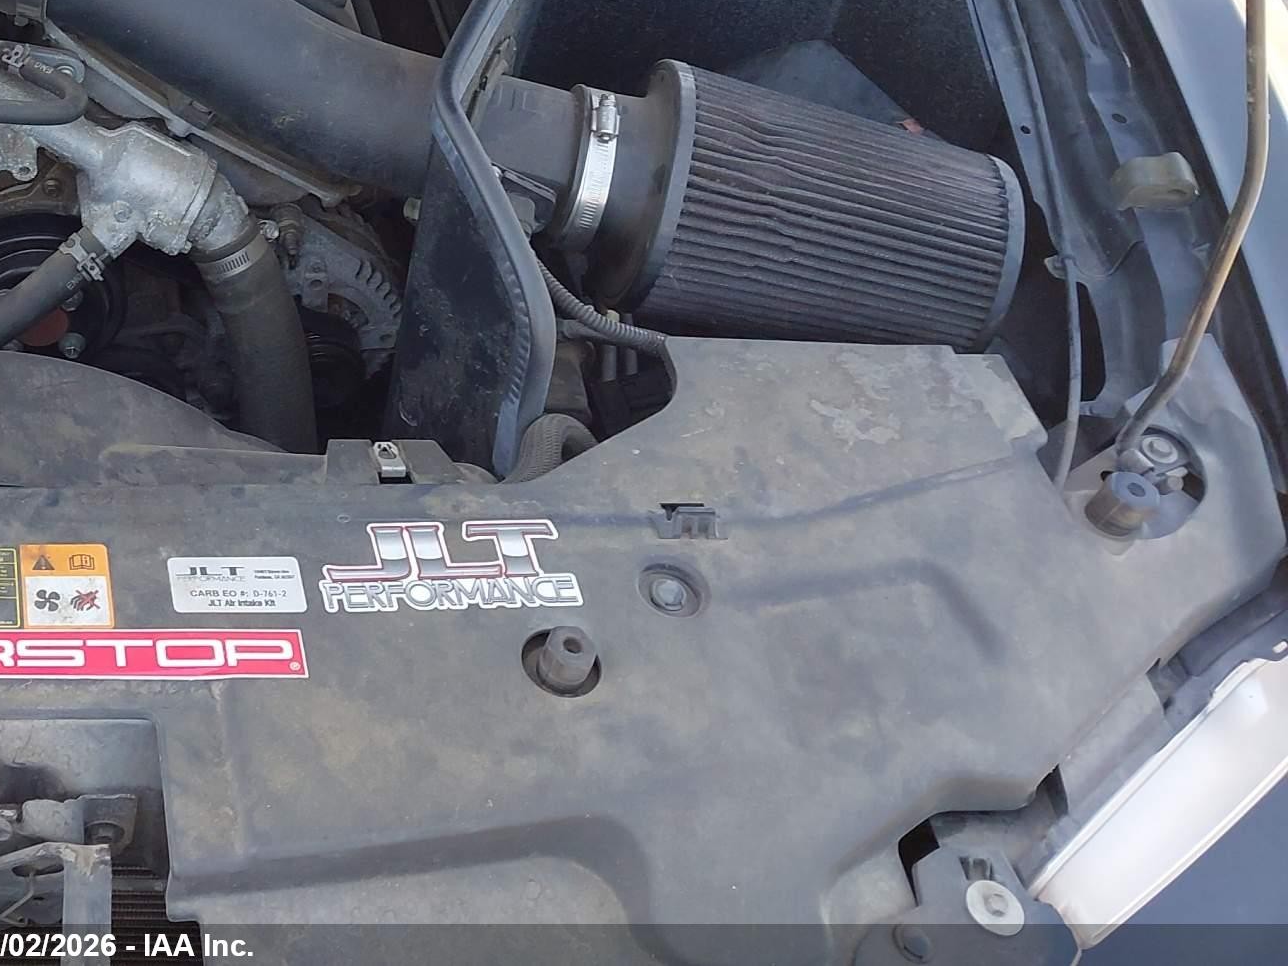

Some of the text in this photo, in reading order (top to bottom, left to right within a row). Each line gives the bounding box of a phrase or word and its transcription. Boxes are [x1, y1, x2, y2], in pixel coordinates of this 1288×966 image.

[324, 522, 556, 583] JLT
[175, 566, 245, 577] JLT
[190, 589, 220, 598] CARB
[222, 589, 238, 598] EO
[321, 576, 581, 610] PERFORMANCE
[224, 599, 236, 607] Air
[238, 599, 263, 607] Intake
